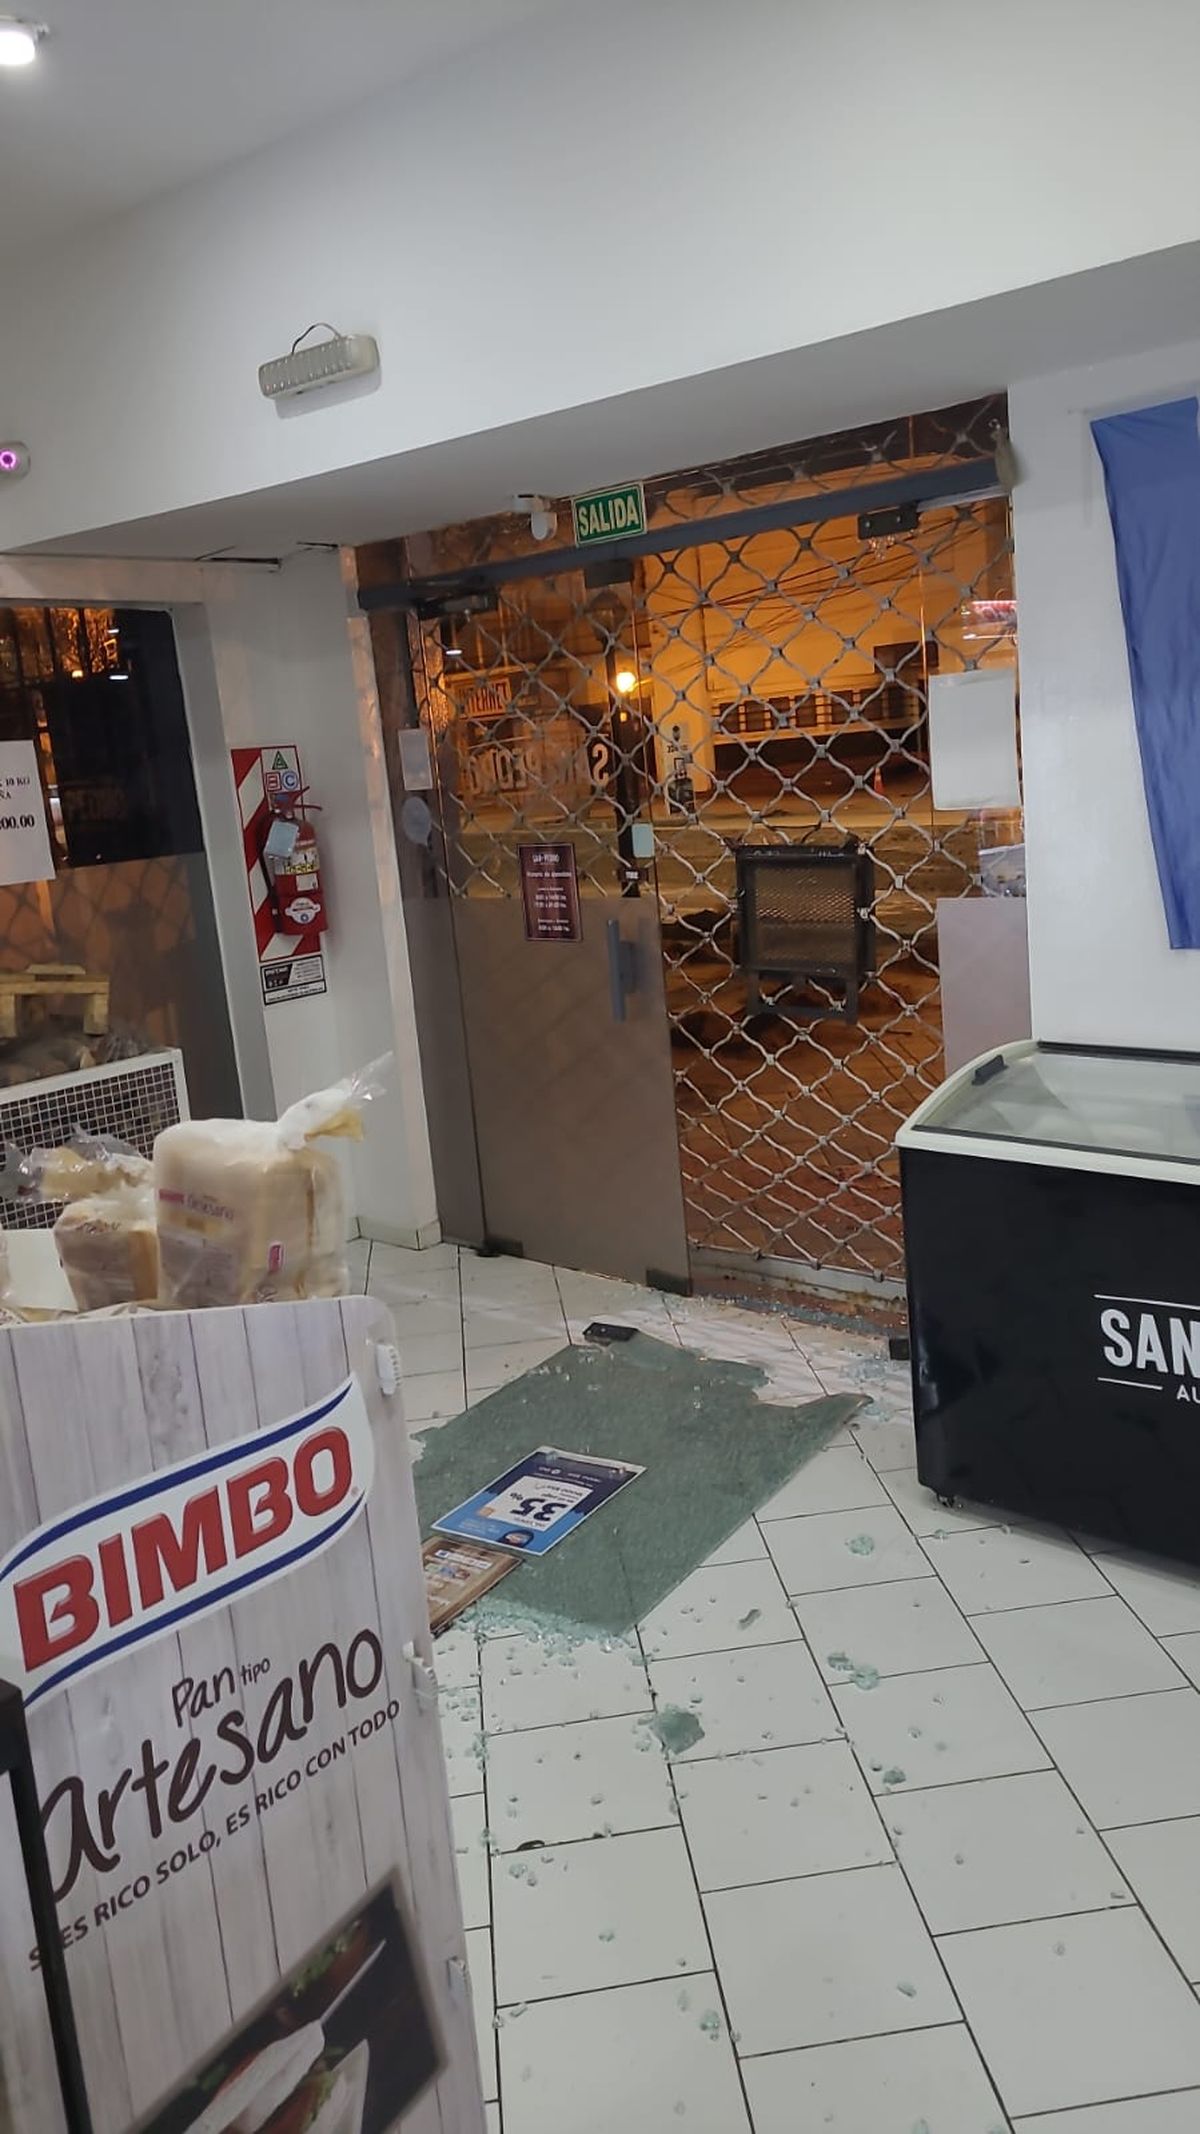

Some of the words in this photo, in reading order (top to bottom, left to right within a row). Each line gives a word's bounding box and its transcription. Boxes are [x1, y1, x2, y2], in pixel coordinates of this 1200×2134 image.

[578, 495, 640, 537] SALIDA
[1100, 1308, 1200, 1378] SAN
[13, 1426, 352, 1673] BIMBO
[172, 1667, 236, 1728] Pan
[240, 1657, 271, 1685] tipo
[94, 1874, 151, 1927] RICO
[155, 1829, 222, 1885] SOLO,
[225, 1803, 251, 1836] ES
[254, 1769, 302, 1816] RICO
[305, 1737, 346, 1777] CON
[347, 1700, 400, 1747] TODO
